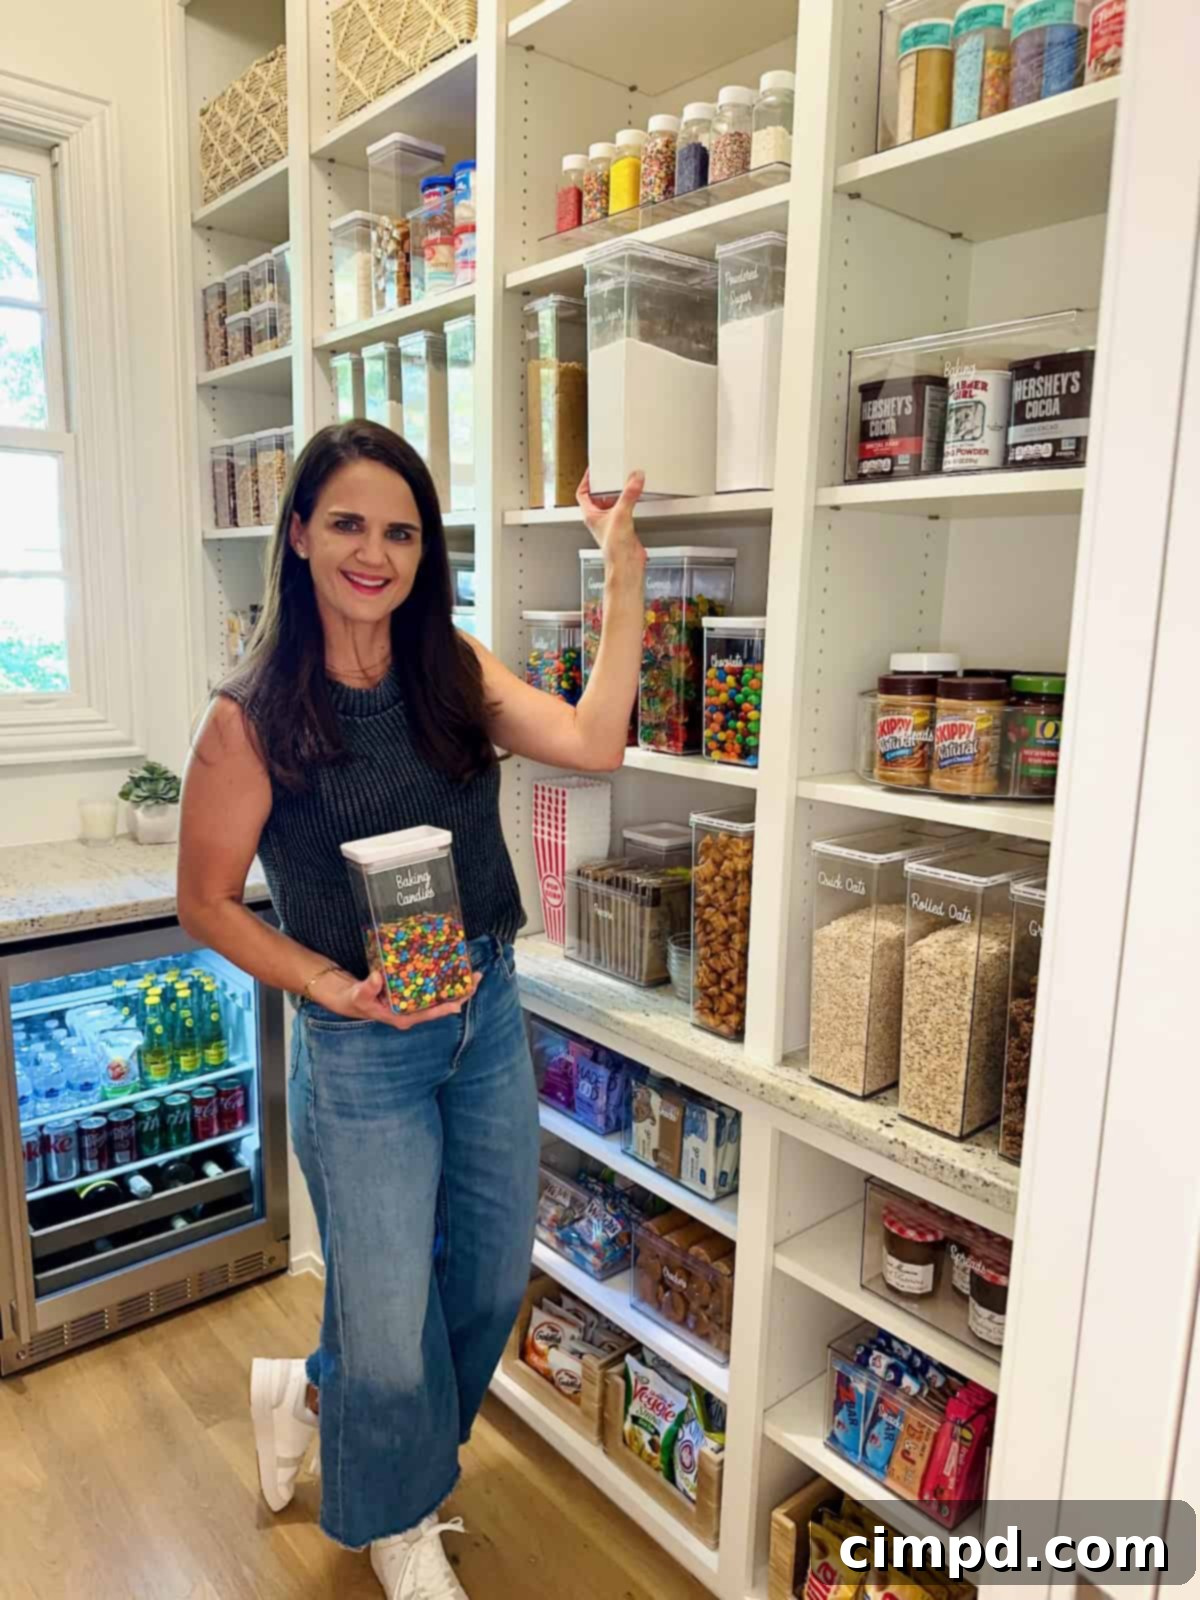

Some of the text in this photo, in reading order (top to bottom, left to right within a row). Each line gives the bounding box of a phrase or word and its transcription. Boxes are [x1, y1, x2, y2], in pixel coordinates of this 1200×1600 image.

[1014, 371, 1080, 402] HERSHEY'S
[1025, 398, 1060, 419] COCOA
[936, 723, 974, 744] SKIPPY
[396, 869, 431, 889] Baking
[818, 872, 866, 895] Quick Oats
[396, 888, 435, 906] Candies
[911, 893, 971, 923] Rolled Oats
[633, 1375, 676, 1423] Veggie
